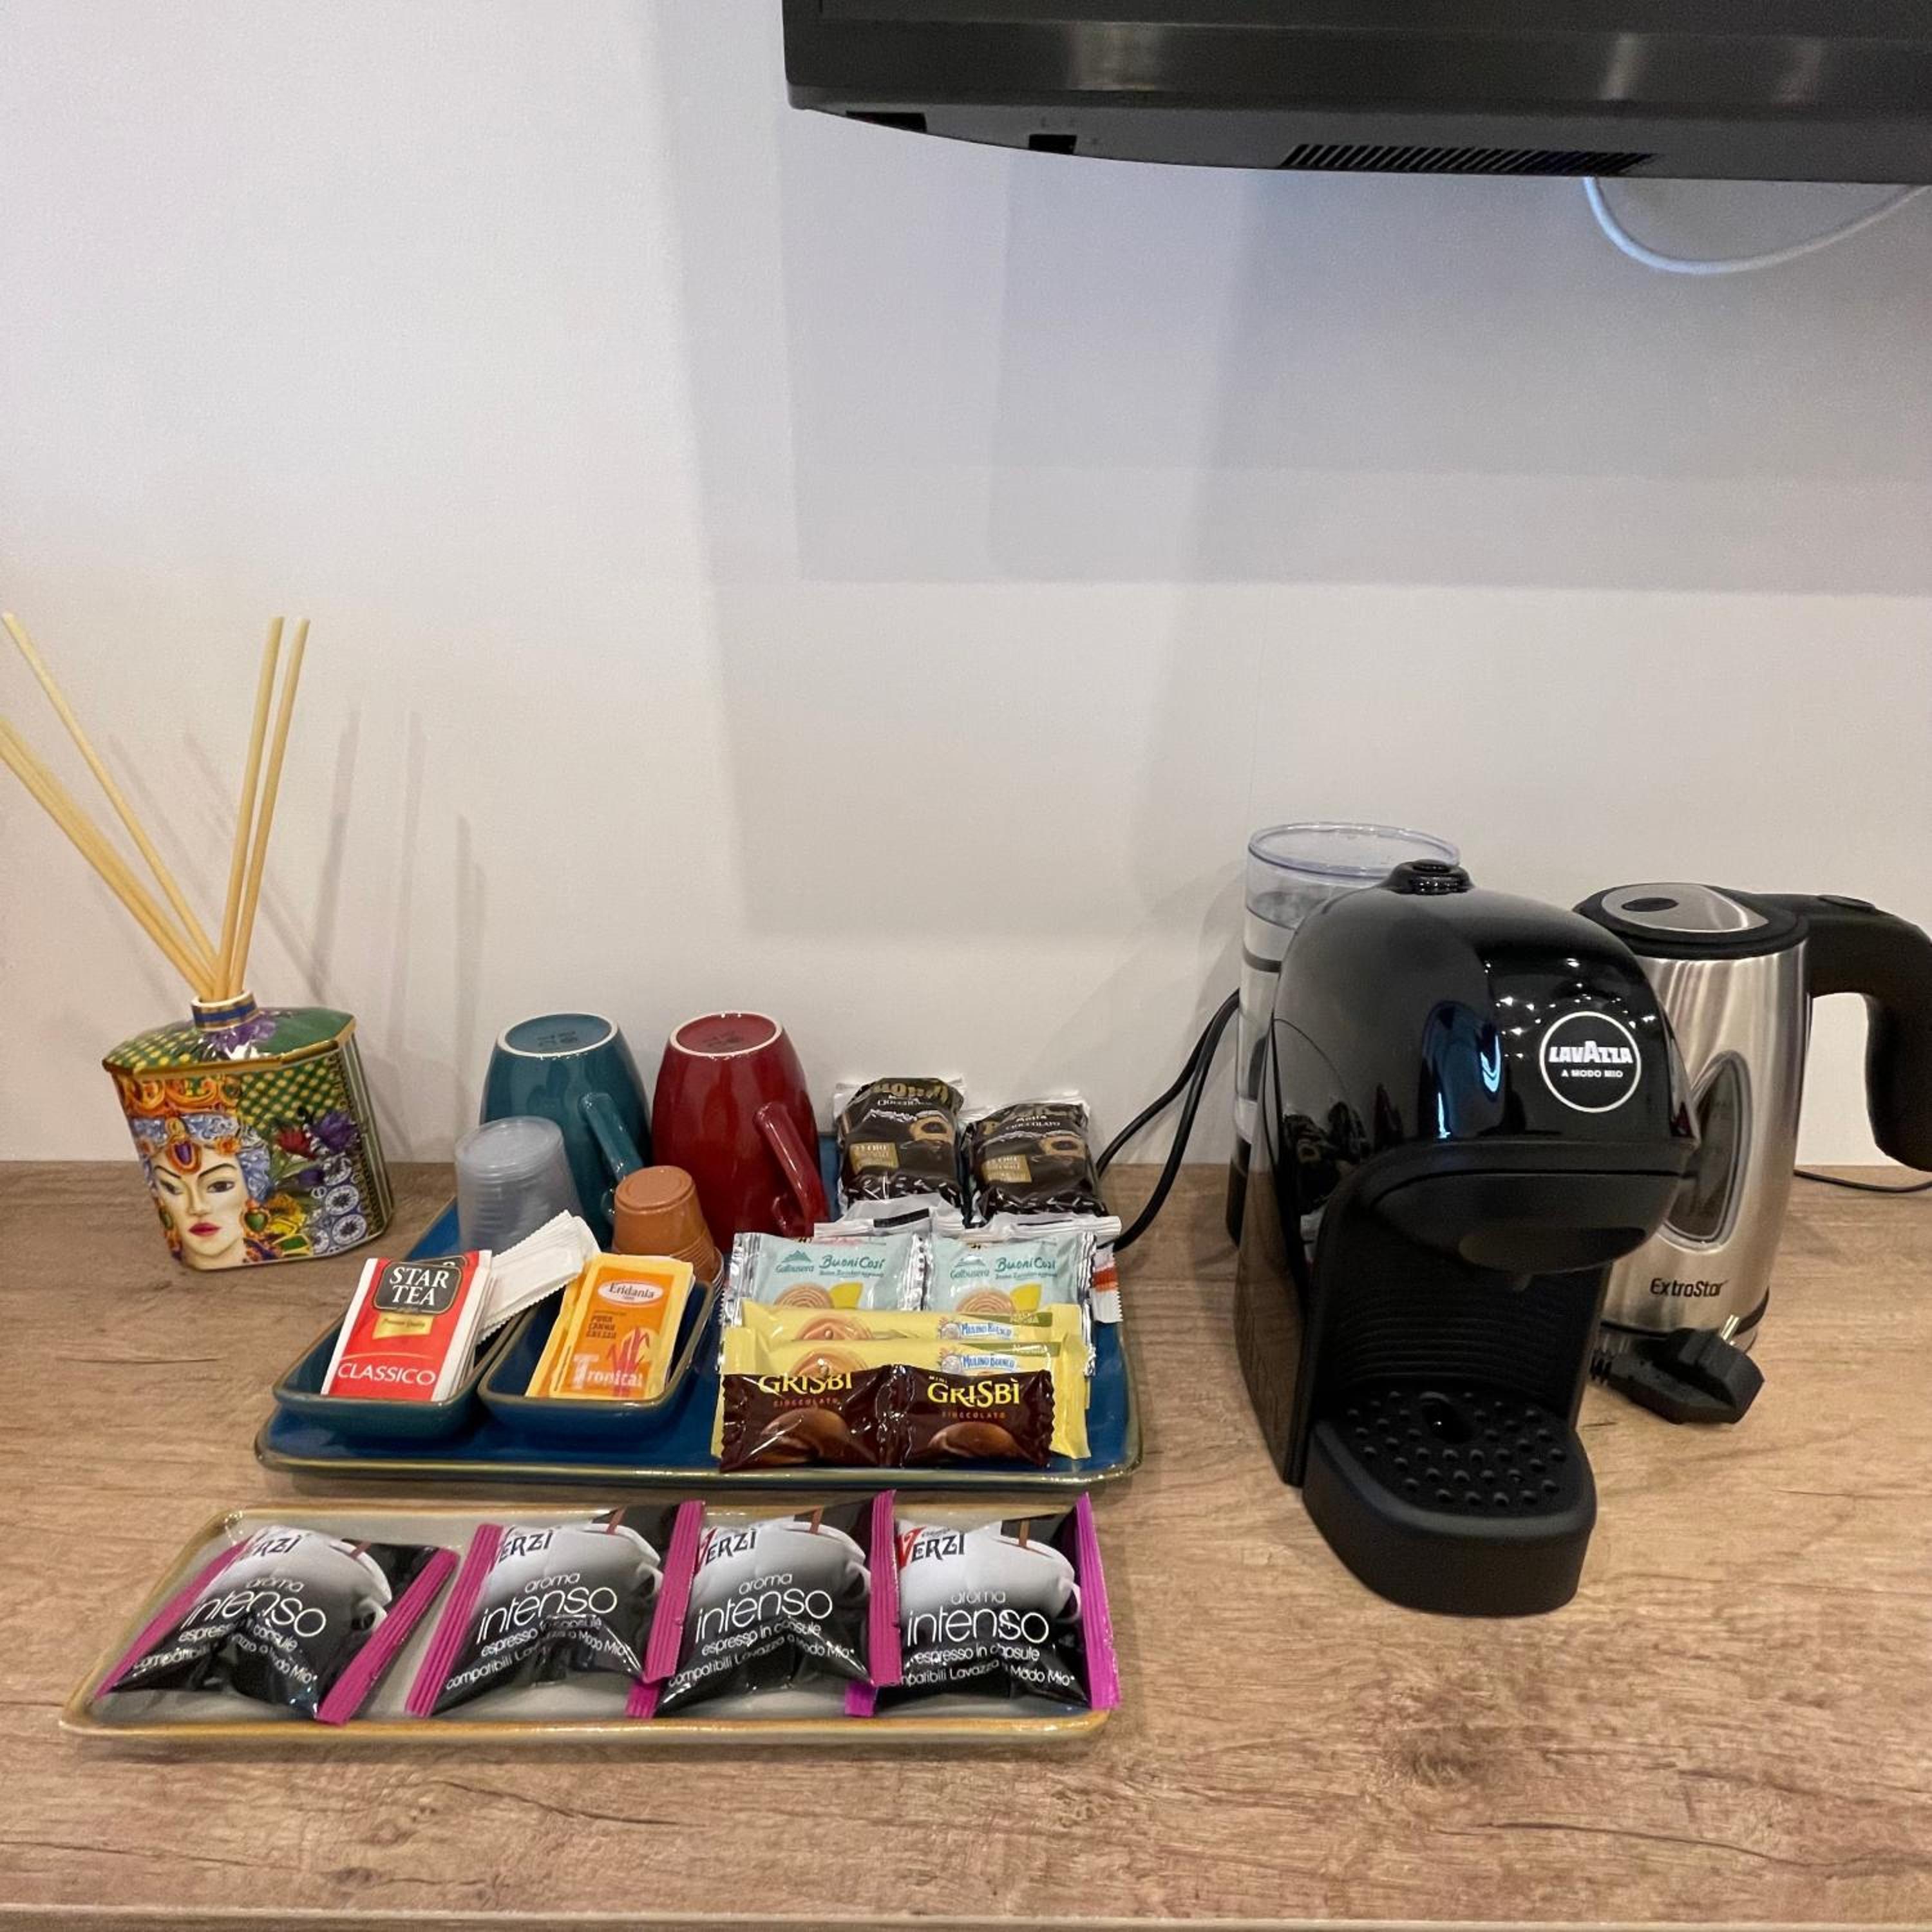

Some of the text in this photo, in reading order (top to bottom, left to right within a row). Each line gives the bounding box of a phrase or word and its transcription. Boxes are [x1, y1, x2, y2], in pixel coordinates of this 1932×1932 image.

[1548, 1040, 1634, 1063] LAVAZZA
[1561, 1069, 1624, 1078] A MODO MIO
[389, 1266, 450, 1289] STAR
[1649, 1276, 1729, 1298] ExtraStar
[392, 1284, 436, 1306] TEA
[608, 1282, 655, 1299] Eridania
[337, 1362, 437, 1386] CLASSICO
[245, 1577, 305, 1594] aroma
[524, 1572, 580, 1595] aroma
[738, 1572, 793, 1595] aroma
[951, 1591, 1007, 1605] aroma
[181, 1589, 327, 1638] intenso
[476, 1586, 618, 1645] intenso
[695, 1587, 833, 1644] intenso
[907, 1606, 1050, 1647] intenso
[480, 1627, 538, 1658] espresso
[701, 1629, 759, 1656] espresso
[760, 1625, 772, 1640] in
[916, 1648, 974, 1664] espresso
[976, 1643, 988, 1658] in
[446, 1654, 513, 1690] compatibili
[668, 1656, 733, 1688] compatibili
[949, 1659, 999, 1680] Lavazza
[1010, 1665, 1045, 1683] Modo
